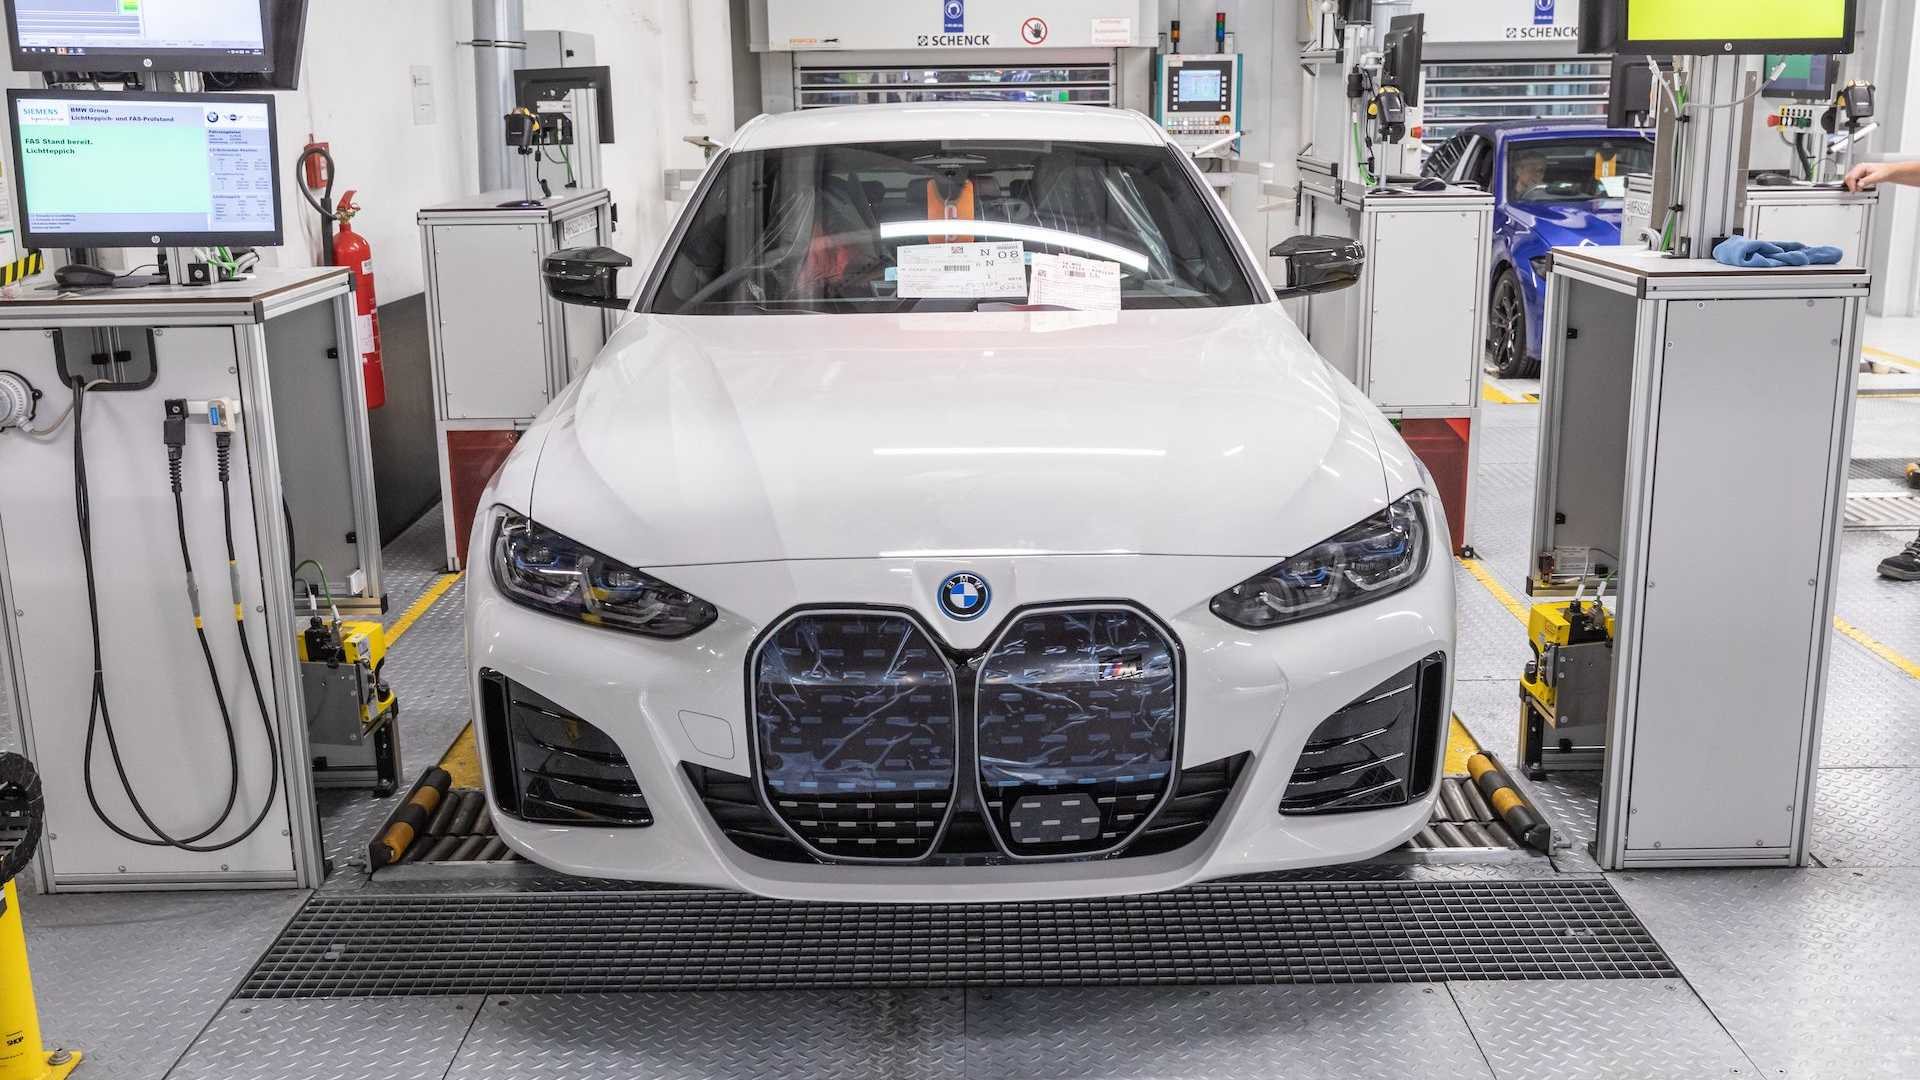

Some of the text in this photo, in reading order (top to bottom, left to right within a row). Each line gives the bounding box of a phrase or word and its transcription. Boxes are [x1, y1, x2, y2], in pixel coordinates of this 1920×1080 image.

[1520, 27, 1578, 38] SCHENCK
[932, 35, 990, 46] SCHENCK
[998, 250, 1019, 259] 08
